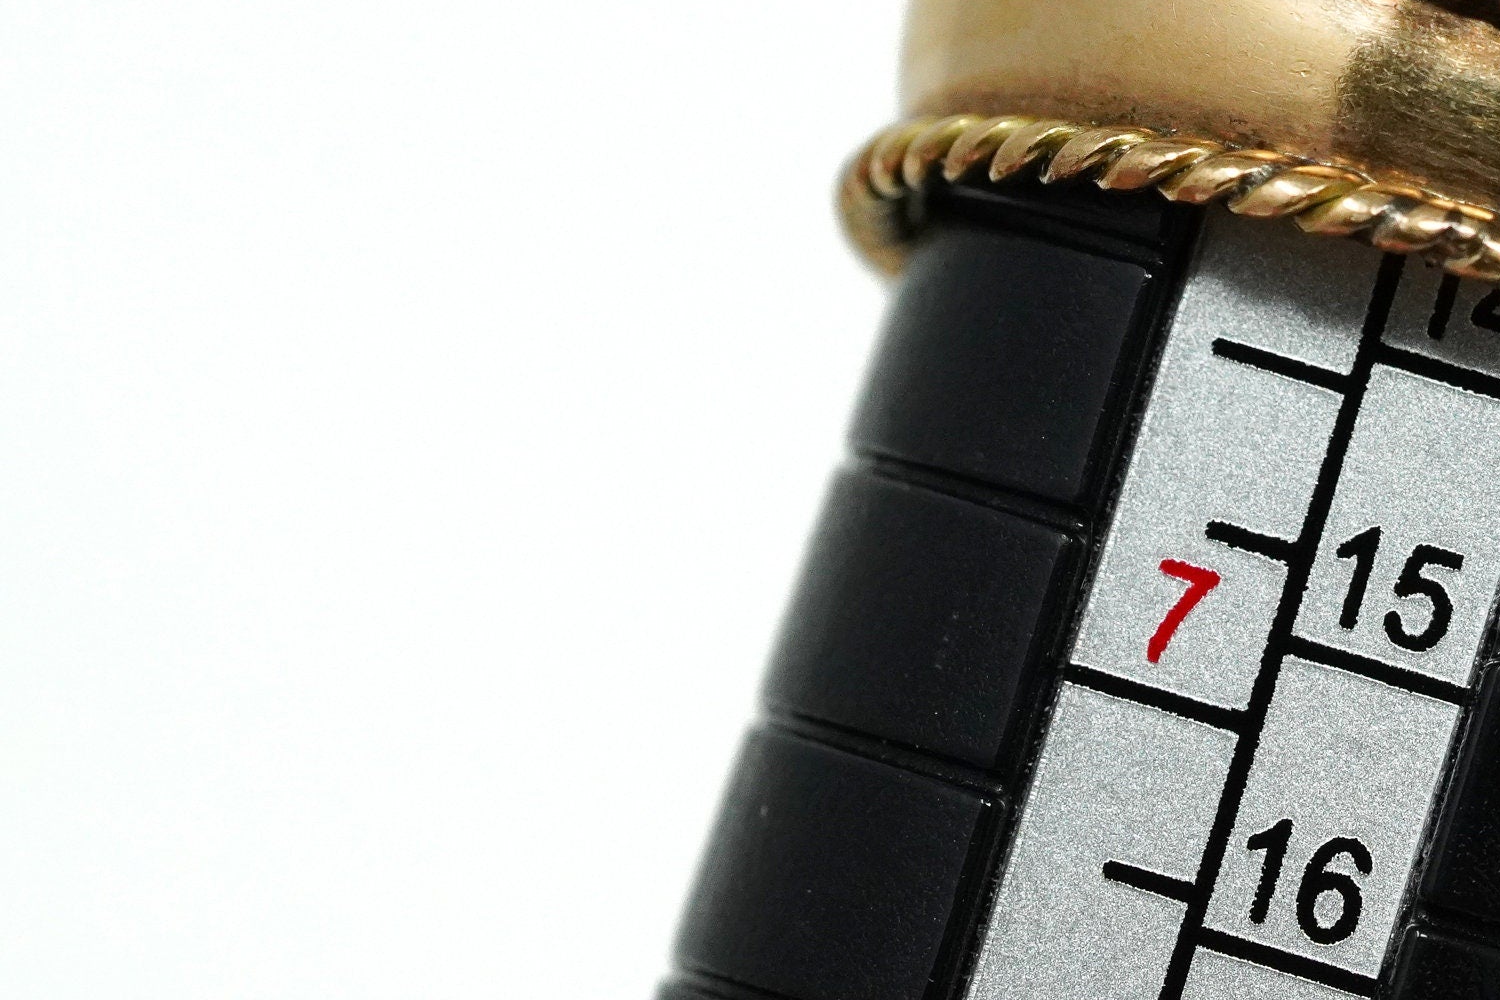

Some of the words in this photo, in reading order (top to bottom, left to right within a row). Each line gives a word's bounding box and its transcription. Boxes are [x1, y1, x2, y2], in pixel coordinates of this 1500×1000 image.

[1146, 557, 1222, 664] 7
[1335, 525, 1465, 653] 15
[1245, 818, 1374, 946] 16
